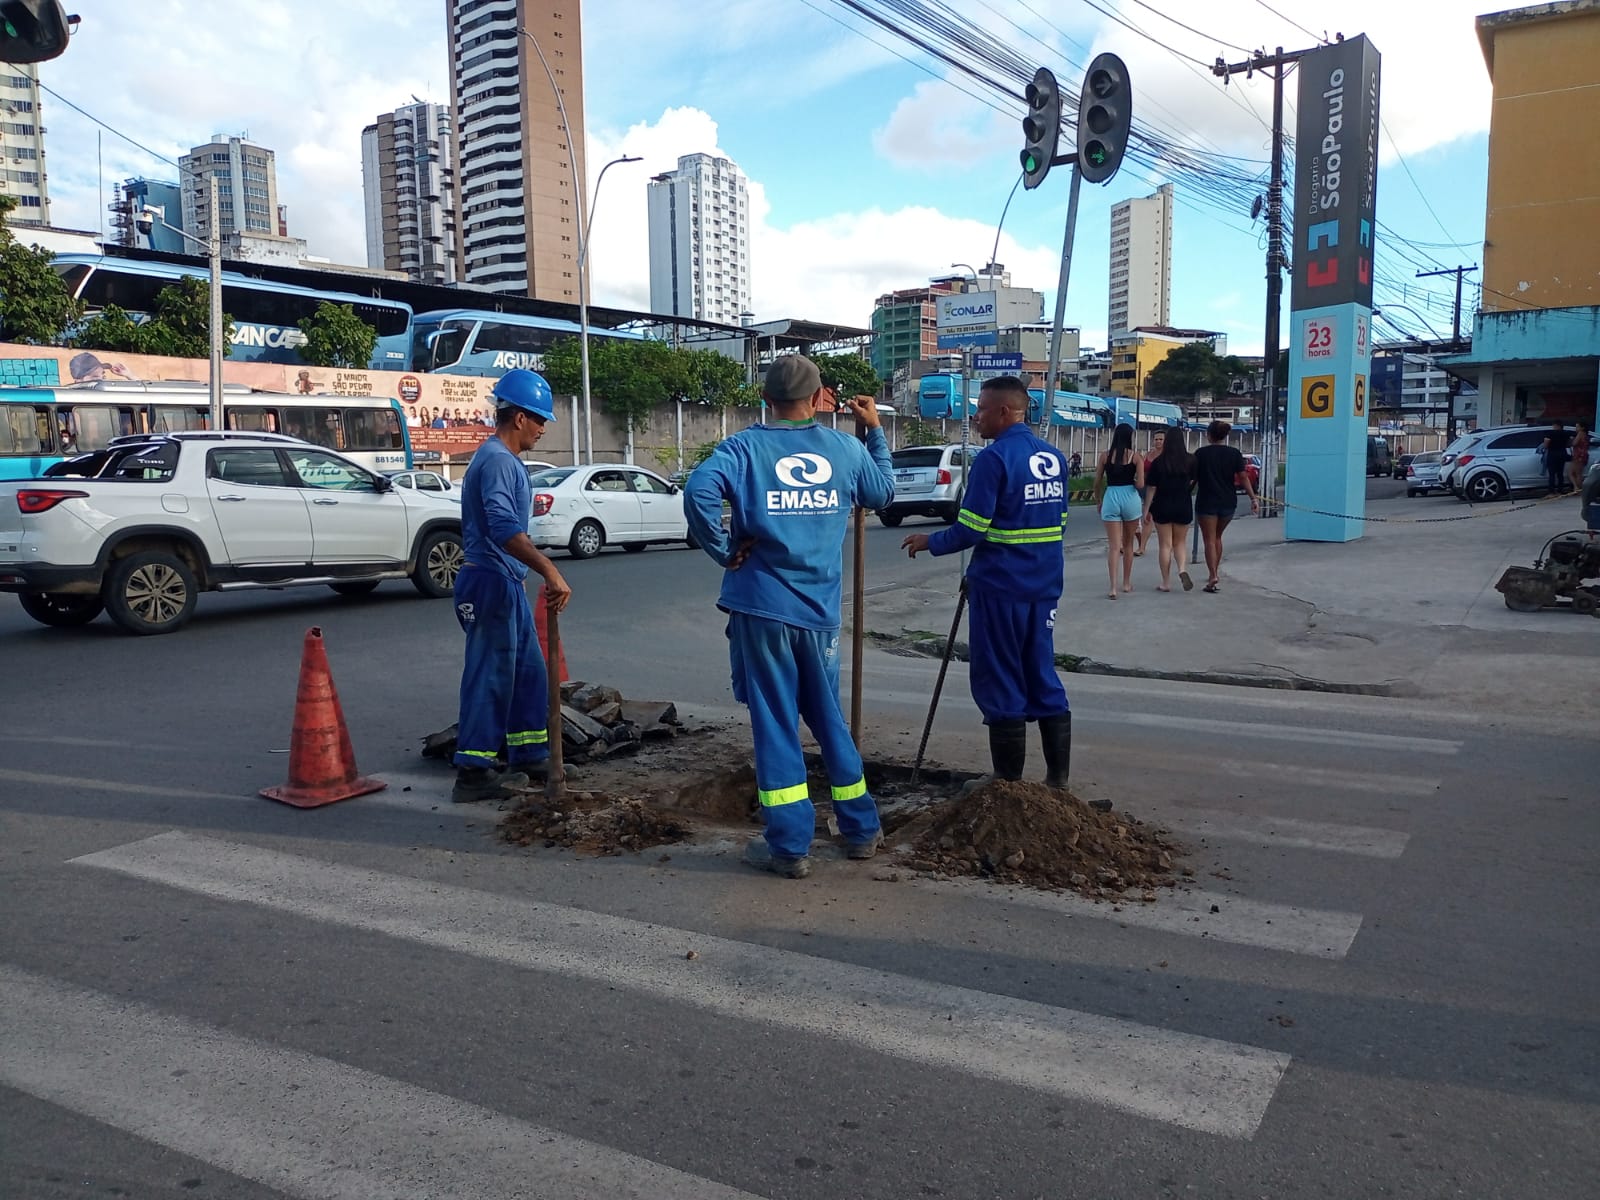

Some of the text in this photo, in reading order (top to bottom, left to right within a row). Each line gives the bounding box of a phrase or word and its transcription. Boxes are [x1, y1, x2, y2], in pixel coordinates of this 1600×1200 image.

[1308, 156, 1320, 215] Drogaria
[950, 304, 993, 317] CONLAR
[1308, 326, 1331, 348] 23
[1357, 325, 1365, 346] 23
[1308, 349, 1331, 357] horas
[977, 358, 1017, 367] ITAJUÍPE
[348, 382, 373, 391] PEDRO
[460, 389, 478, 397] JULHO
[1307, 381, 1329, 413] G
[1355, 379, 1363, 411] G
[375, 456, 405, 464] 881540
[767, 489, 839, 509] EMASA
